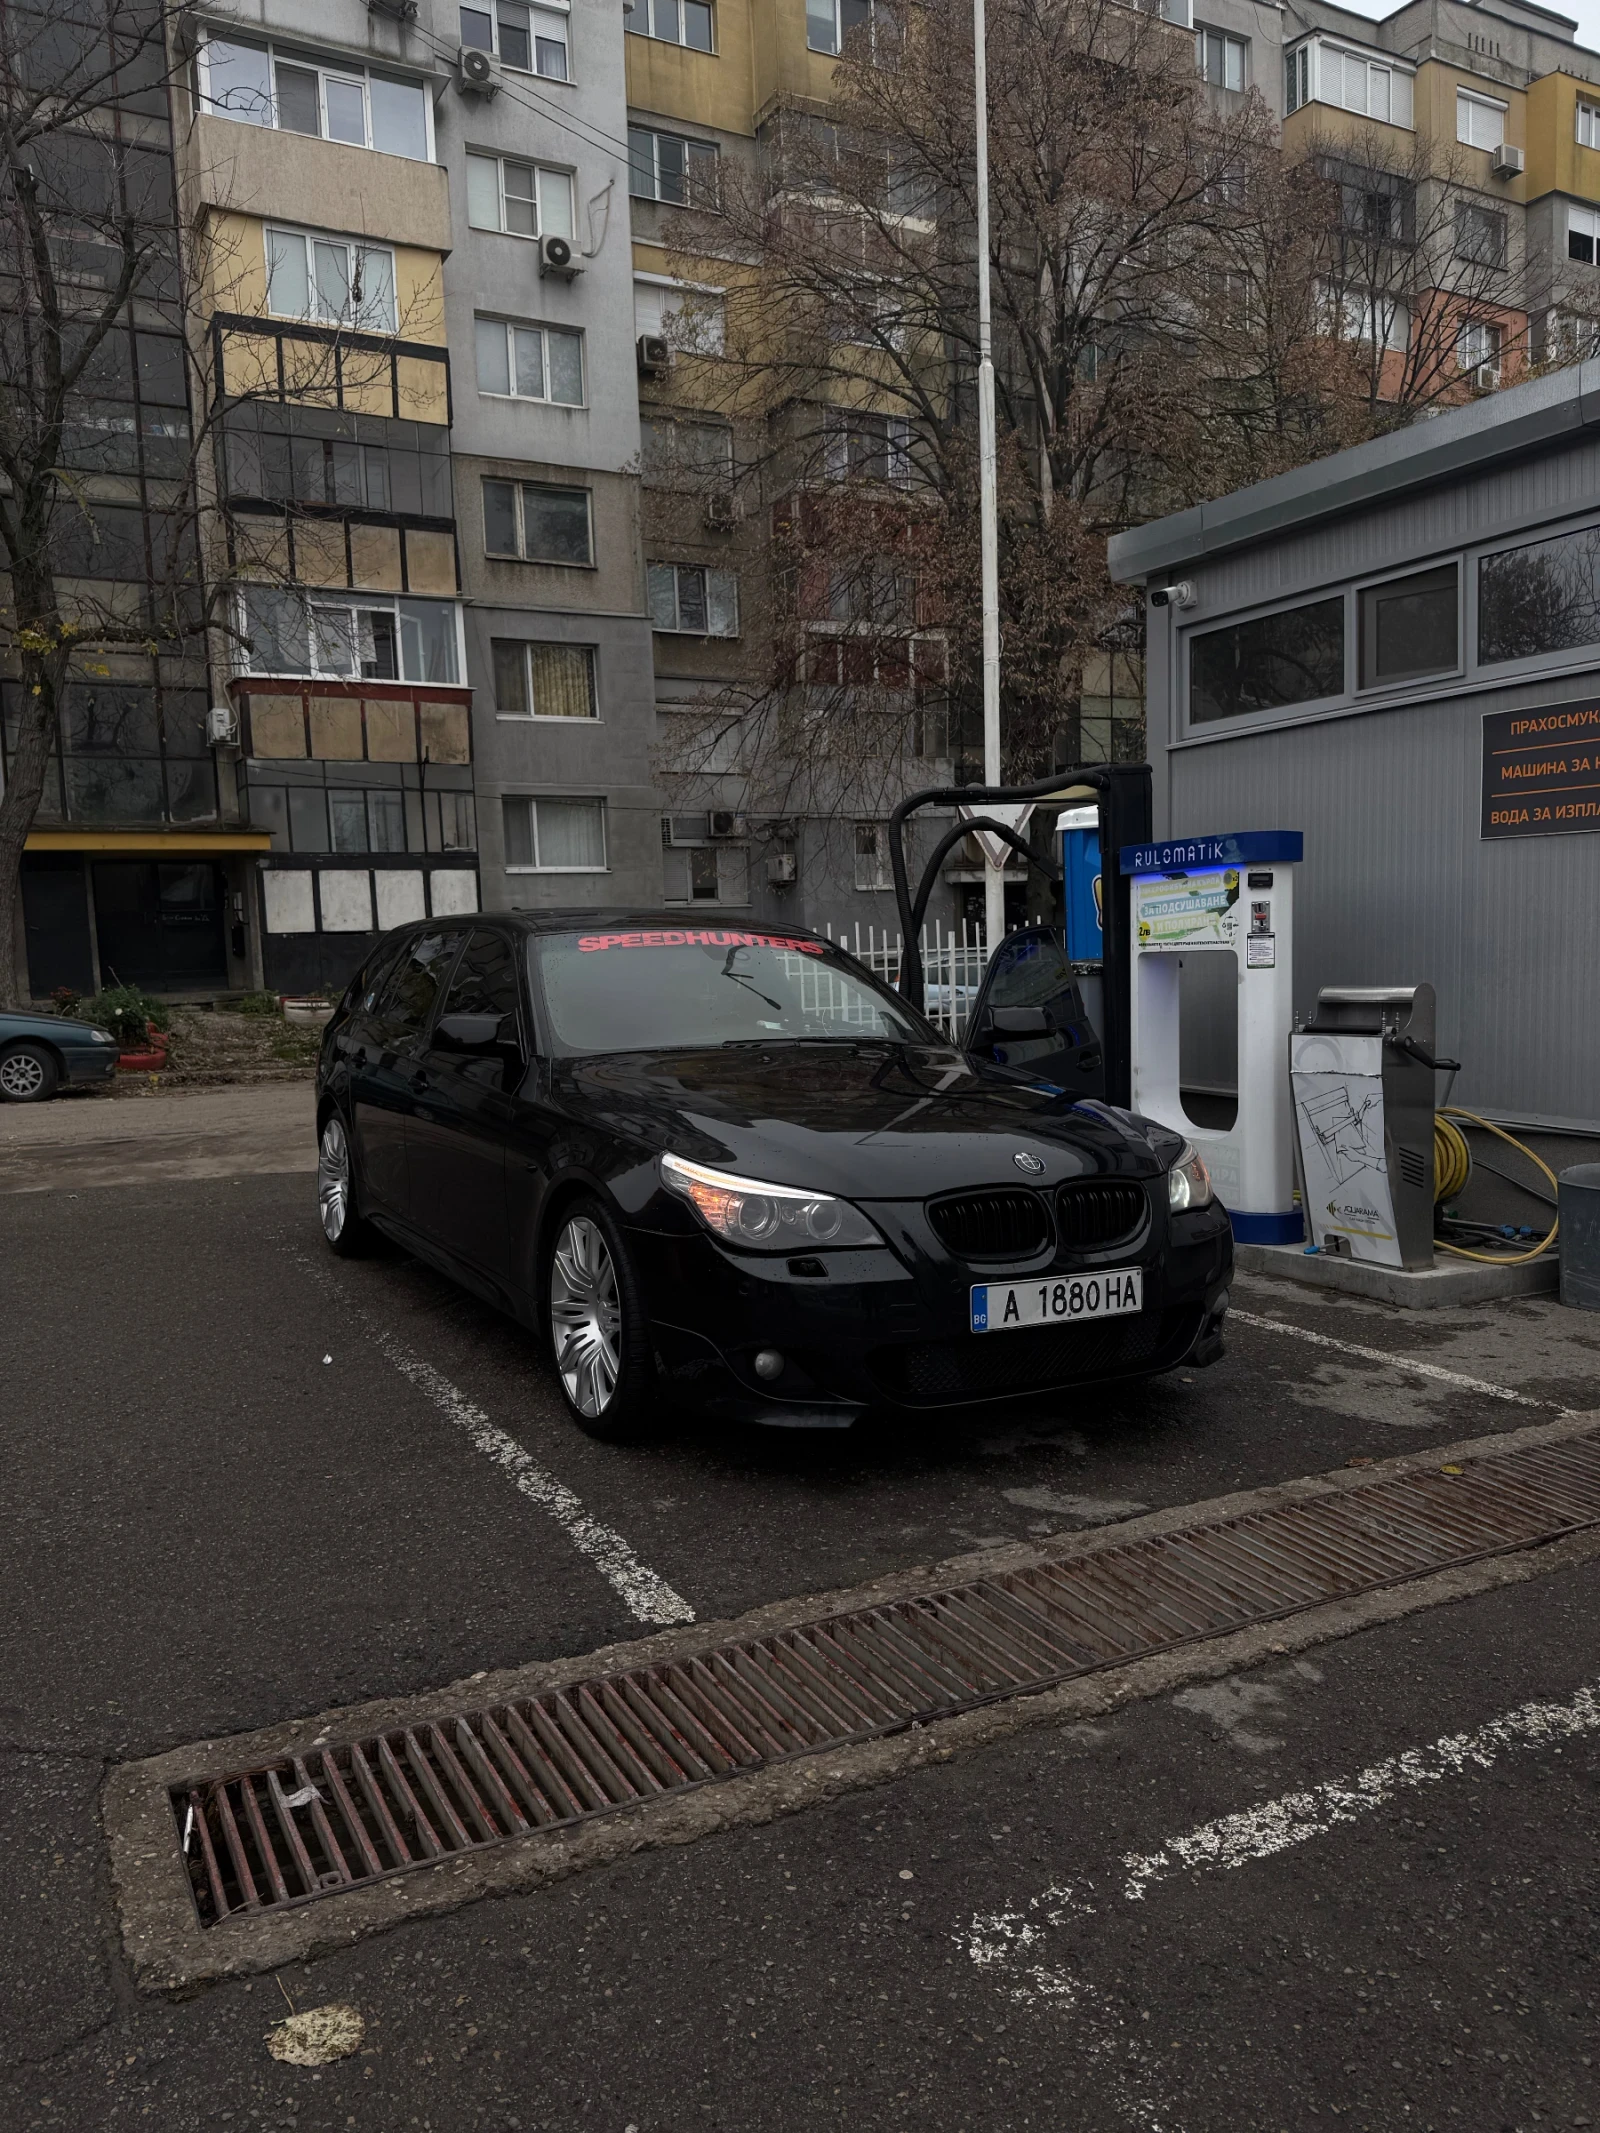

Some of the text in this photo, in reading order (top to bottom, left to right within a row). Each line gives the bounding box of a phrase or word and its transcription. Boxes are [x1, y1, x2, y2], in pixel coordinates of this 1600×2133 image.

[1511, 709, 1600, 736] ПРАХОСМУК
[1501, 760, 1567, 780] МАШИНА
[1571, 758, 1590, 771] ЗА
[1491, 809, 1529, 825] ВОДА
[1533, 807, 1551, 821] ЗА
[1144, 895, 1226, 916] ЗА ПОДСУШАВАНЕ
[578, 931, 823, 955] SPEEDHUNTERS
[1003, 1275, 1137, 1322] A 1880 HA
[974, 1314, 986, 1325] BG
